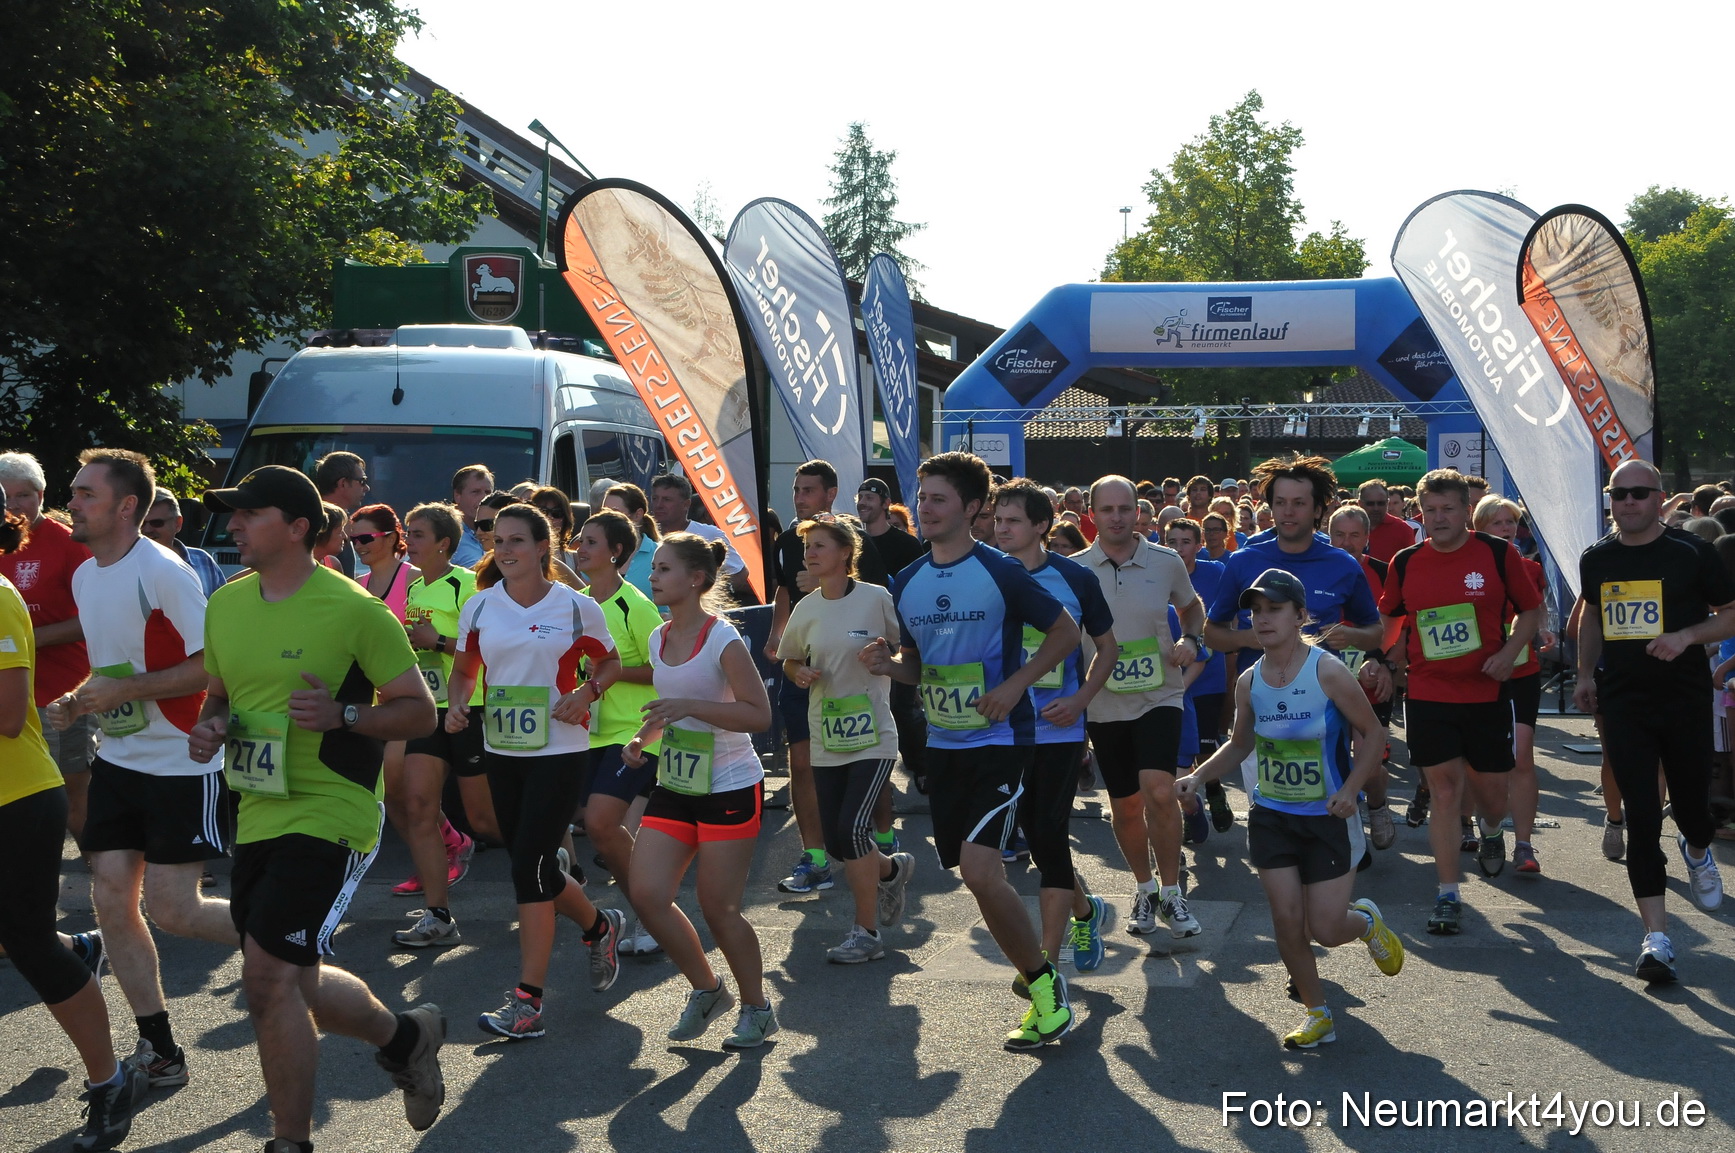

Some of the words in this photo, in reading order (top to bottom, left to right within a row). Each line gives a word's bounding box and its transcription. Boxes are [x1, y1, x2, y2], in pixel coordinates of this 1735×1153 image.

[481, 306, 506, 318] 1628
[1216, 303, 1250, 314] Fischer
[1191, 322, 1290, 342] firmenlauf
[1191, 341, 1232, 349] neumarkt
[1411, 352, 1426, 360] das
[1005, 354, 1058, 369] Fischer
[1604, 601, 1660, 625] 1078
[935, 628, 954, 636] TEAM
[1428, 622, 1469, 646] 148
[1112, 657, 1154, 681] 843
[924, 685, 981, 713] 1214
[492, 708, 537, 734] 116
[822, 713, 874, 738] 1422
[230, 739, 275, 776] 274
[664, 748, 700, 779] 117
[1260, 757, 1321, 786] 1205
[334, 893, 346, 911] DKV
[285, 934, 307, 947] adidas
